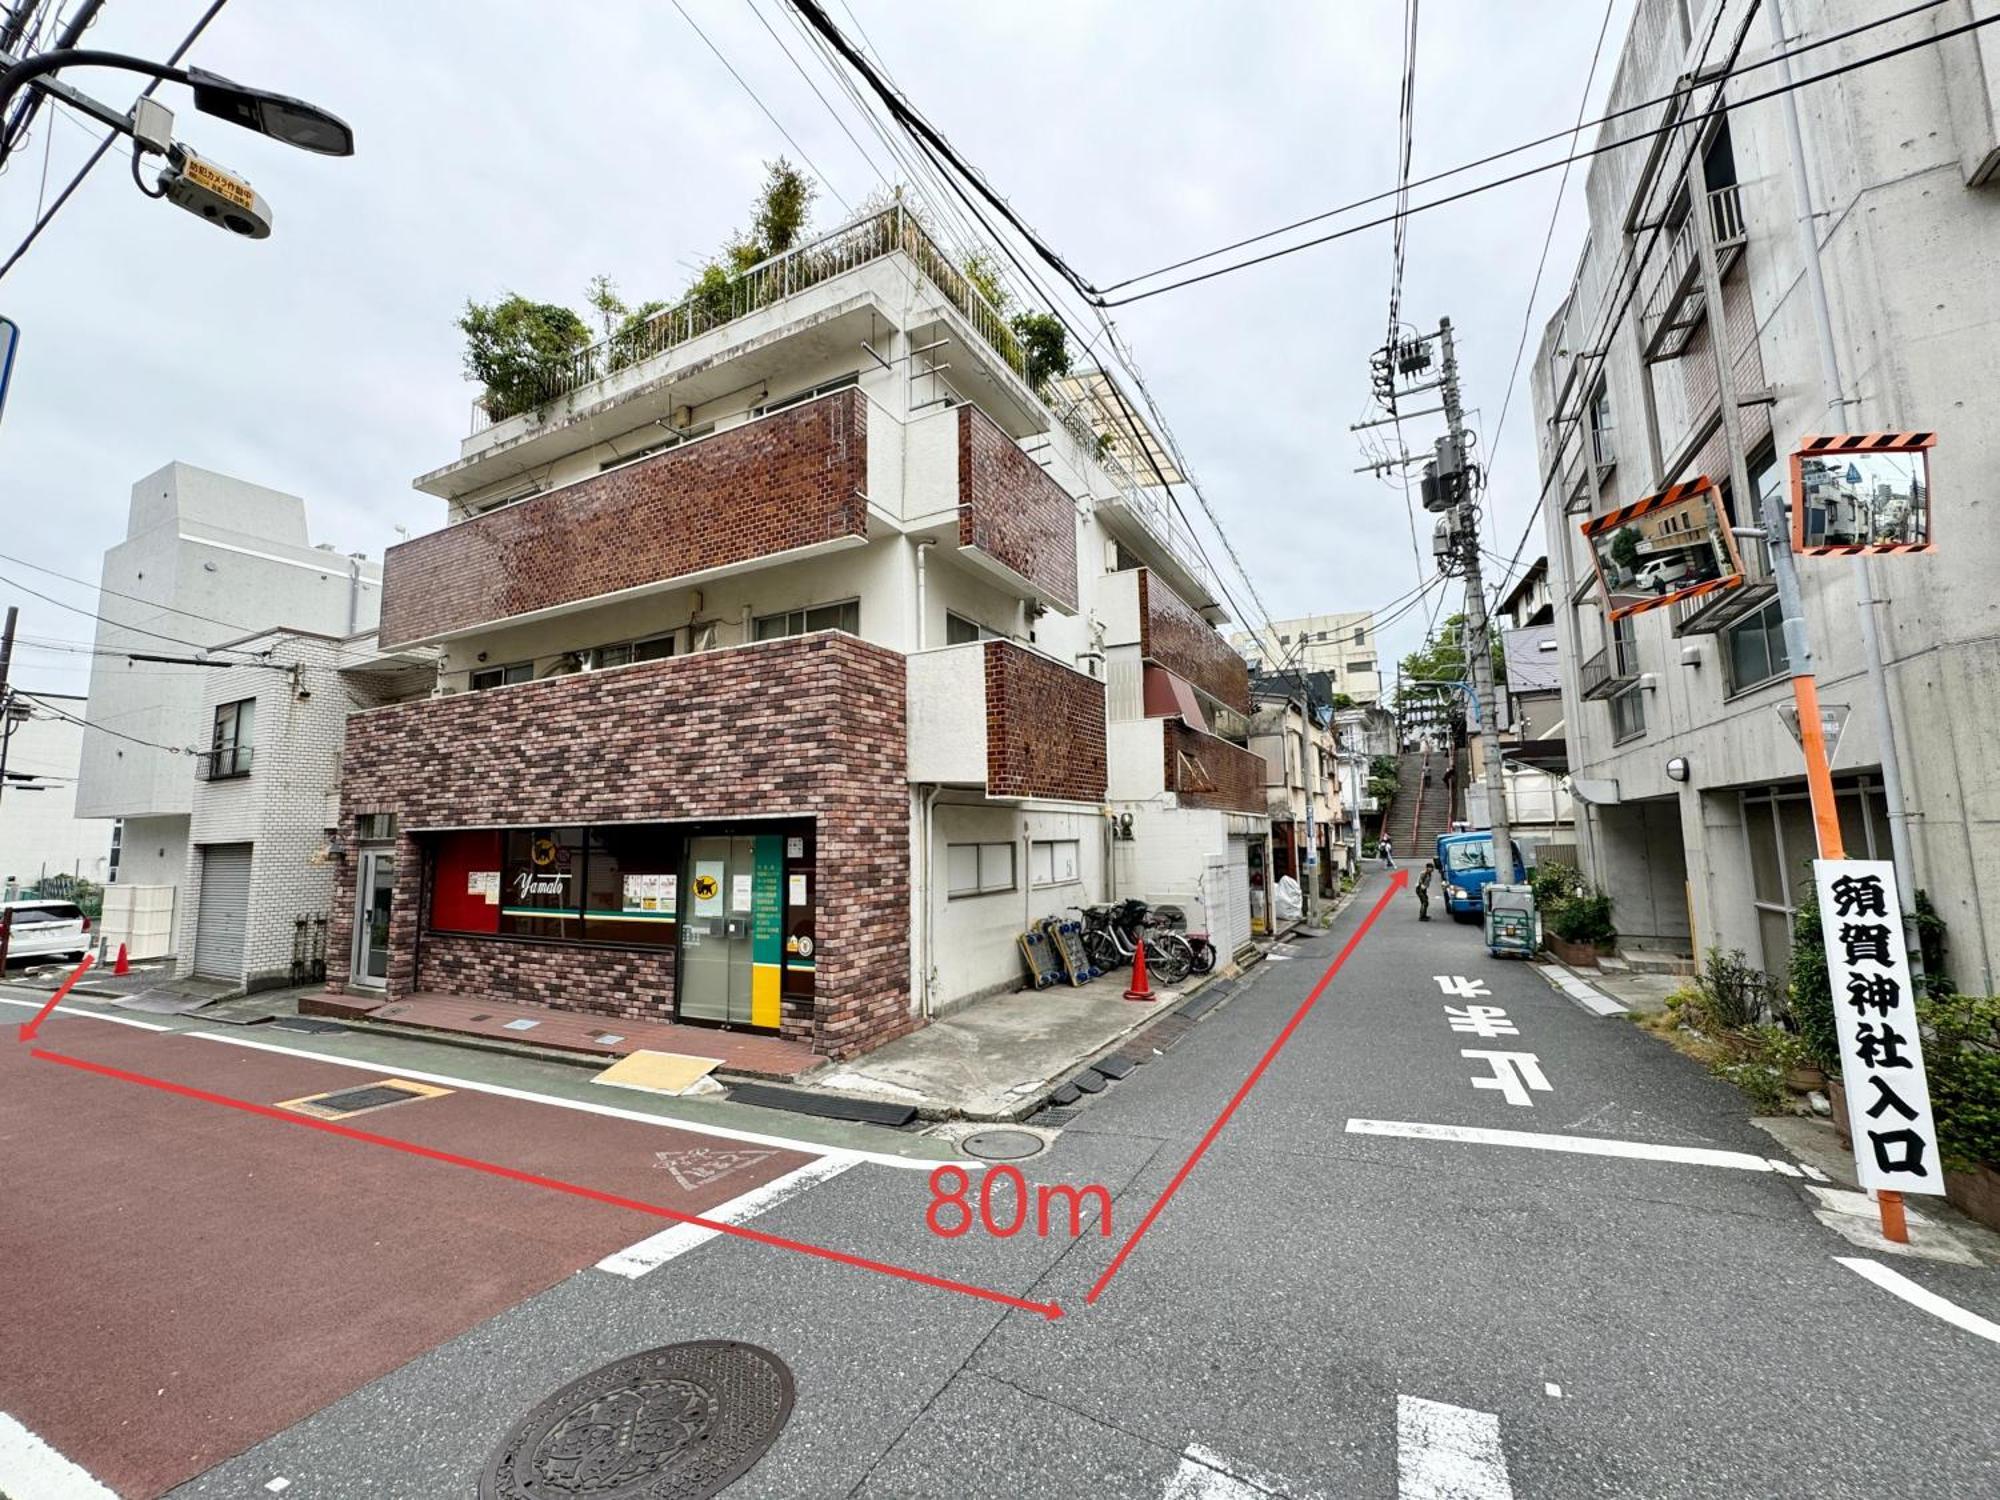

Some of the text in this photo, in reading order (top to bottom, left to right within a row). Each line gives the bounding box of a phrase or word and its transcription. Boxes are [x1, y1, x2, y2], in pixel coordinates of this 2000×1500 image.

[513, 872, 572, 899] Yamato
[1433, 975, 1554, 1106] 止まれ
[1832, 874, 1928, 1177] 須賀神社入口
